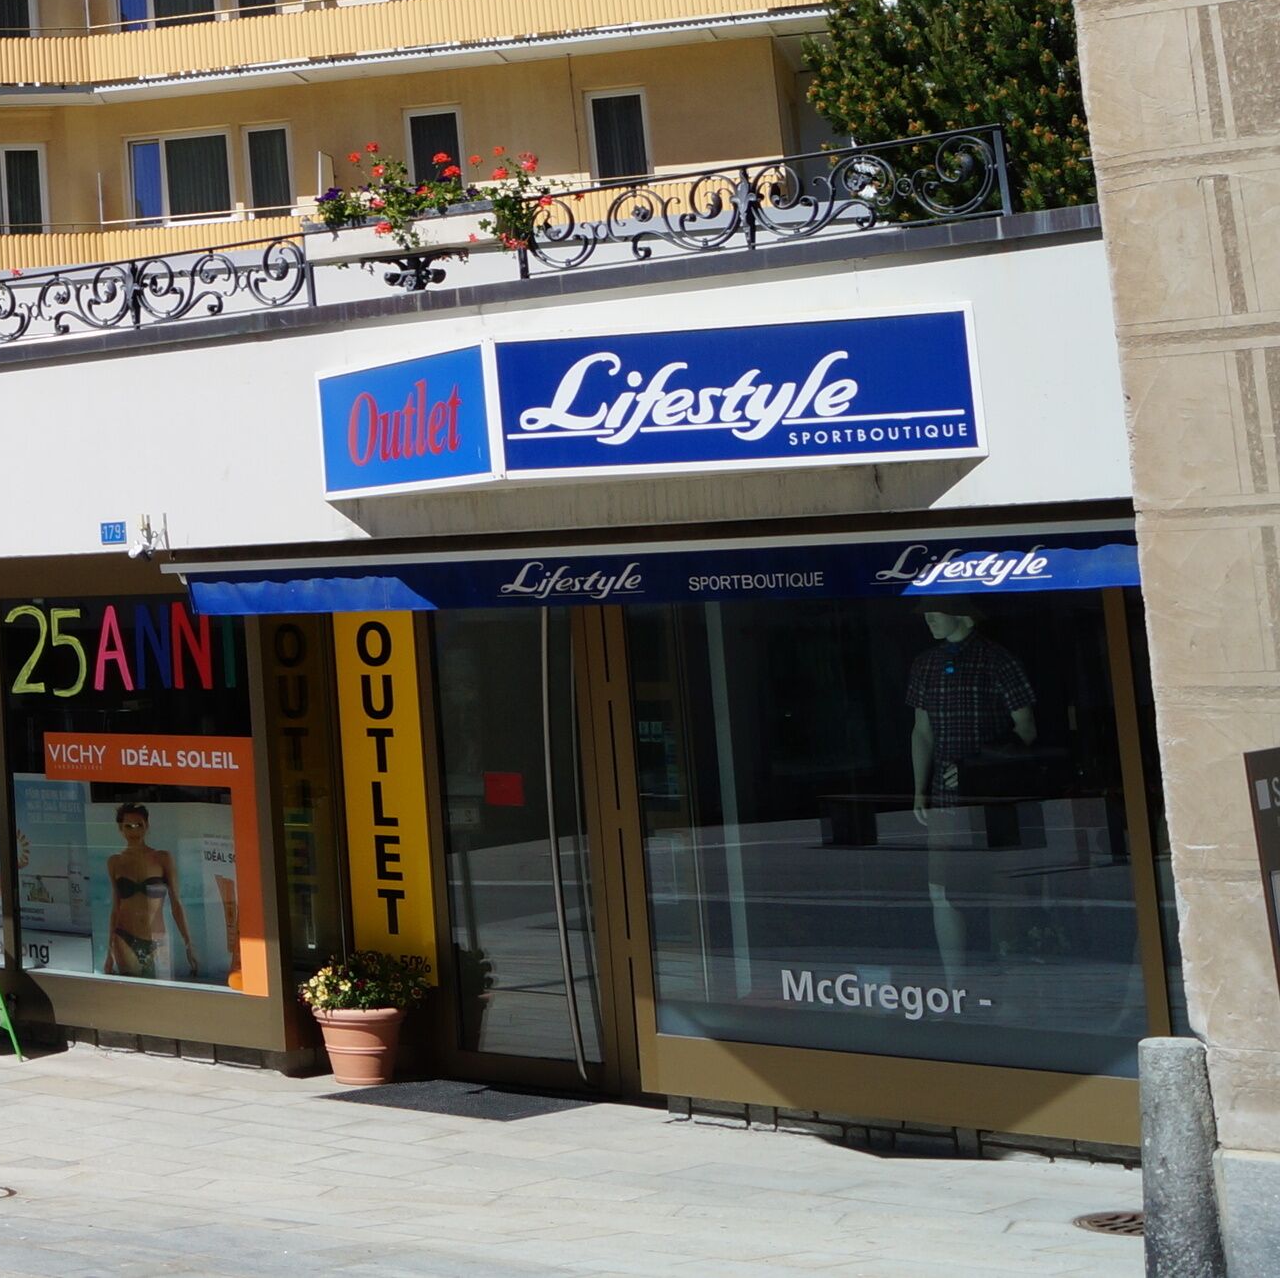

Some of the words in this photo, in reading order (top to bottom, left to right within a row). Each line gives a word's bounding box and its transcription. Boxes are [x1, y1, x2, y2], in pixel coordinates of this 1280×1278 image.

[347, 379, 463, 467] Outlet
[519, 350, 859, 446] Lifestyle
[788, 422, 968, 447] SPORTBOUTIQUE
[103, 525, 121, 540] 179
[501, 561, 642, 599] Lifestyle
[688, 571, 825, 591] SPORTBOUTIQUE
[876, 544, 1049, 587] Lifestyle
[4, 605, 87, 698] 25
[94, 602, 237, 691] ANNI
[48, 744, 106, 764] VICHY
[121, 746, 172, 767] IDÉAL
[176, 750, 239, 770] SOLEIL
[356, 621, 405, 935] OUTLET
[204, 846, 227, 863] IDÉAL
[781, 969, 966, 1020] McGregor
